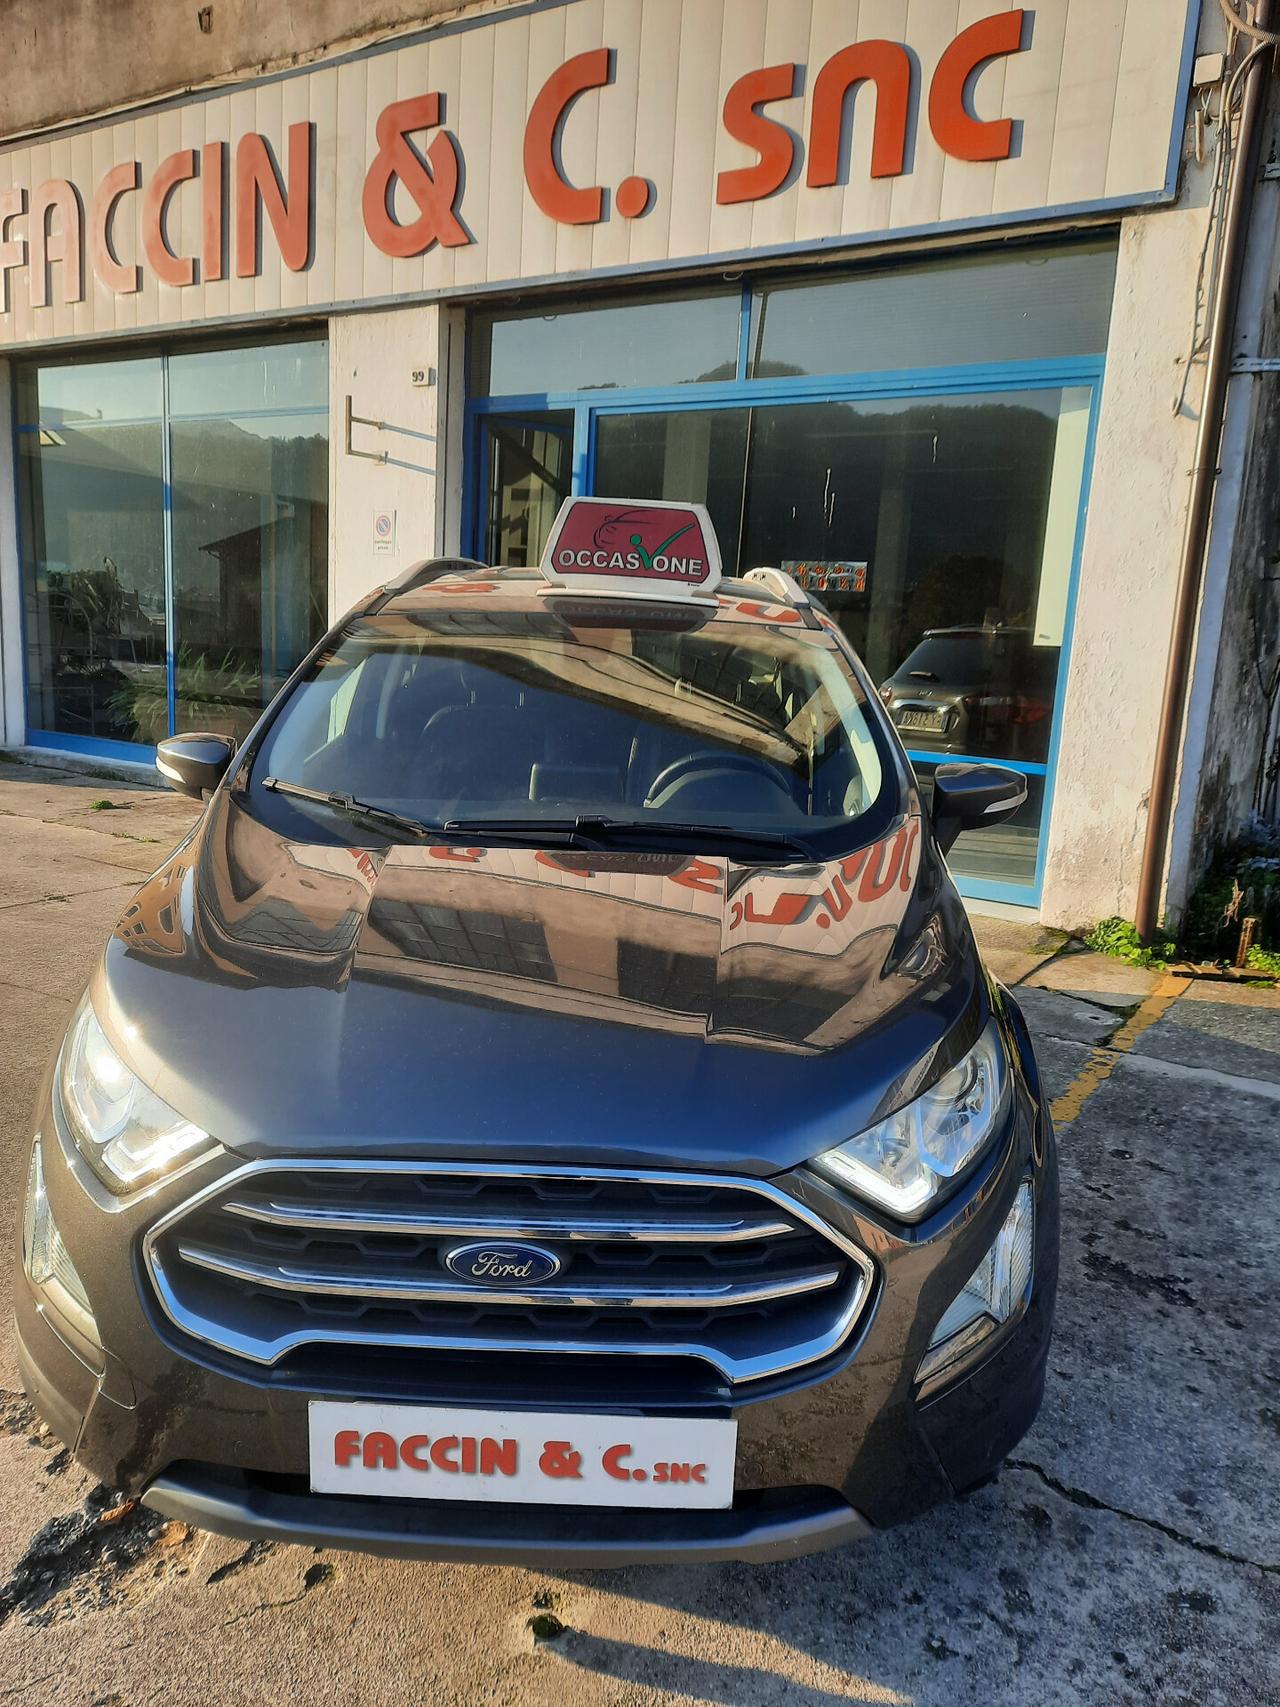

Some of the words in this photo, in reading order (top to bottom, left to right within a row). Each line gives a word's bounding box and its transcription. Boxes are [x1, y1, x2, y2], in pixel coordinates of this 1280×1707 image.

[0, 120, 311, 314] FACCIN
[362, 91, 471, 258] &
[523, 47, 649, 225] C.
[411, 370, 425, 383] 99
[471, 1251, 533, 1277] Ford
[333, 1430, 517, 1477] FACCIN
[538, 1441, 583, 1479] &
